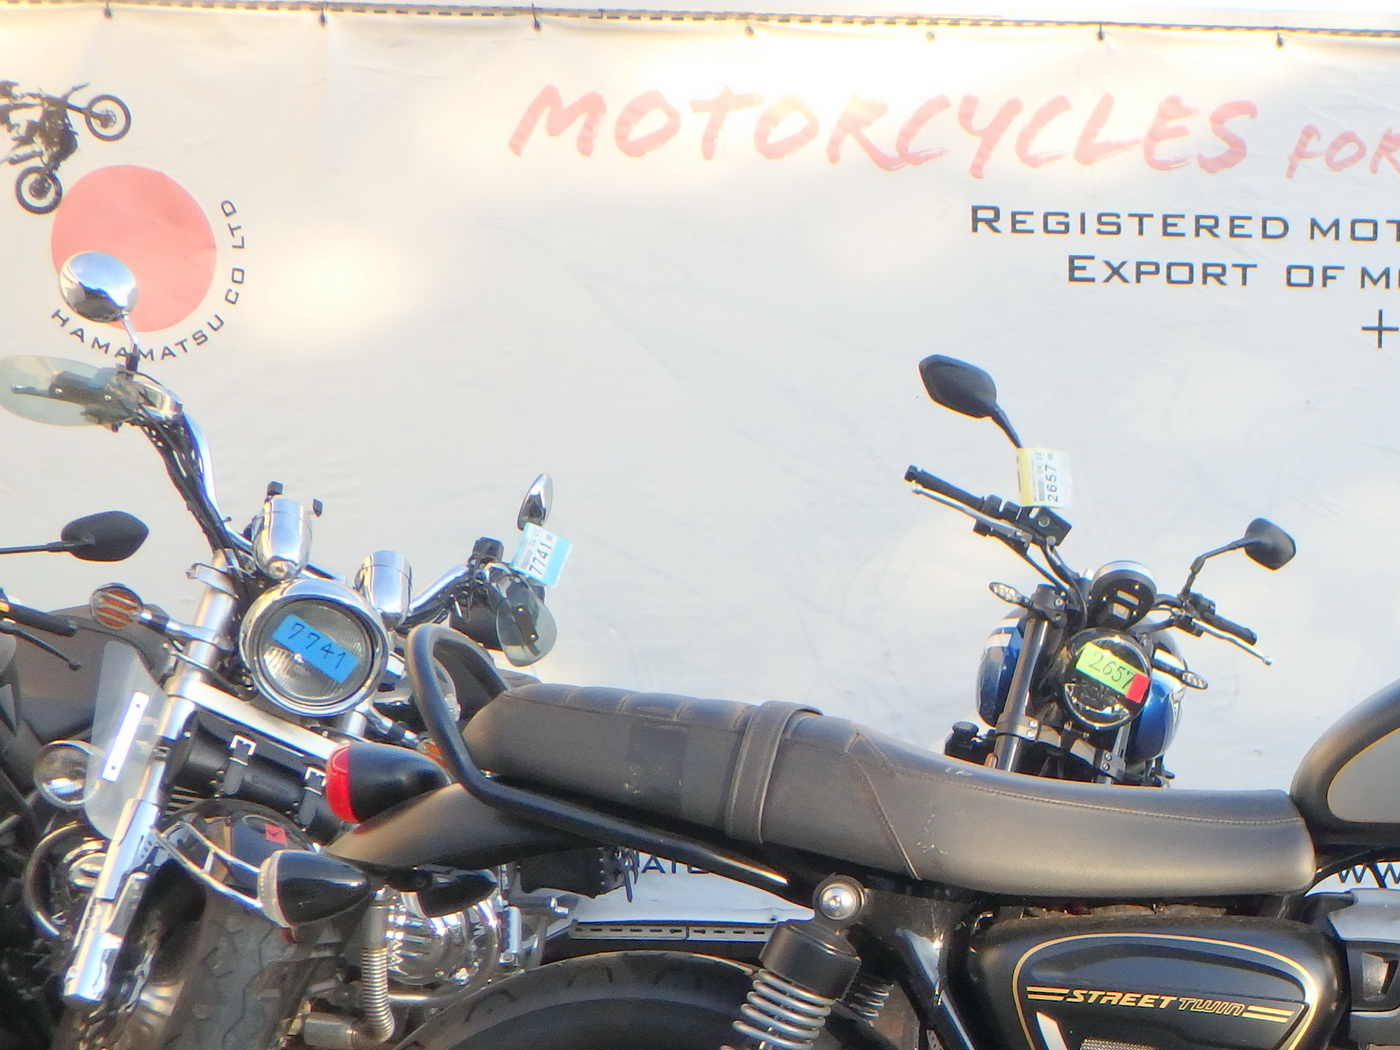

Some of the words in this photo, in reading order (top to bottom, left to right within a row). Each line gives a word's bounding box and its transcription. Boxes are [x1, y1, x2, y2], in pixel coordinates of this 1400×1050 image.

[508, 83, 1259, 179] MOTORCYCLES
[220, 200, 245, 249] LTD
[969, 205, 1290, 240] REGISTERED
[224, 267, 245, 305] CO
[1067, 255, 1258, 287] EXPORT
[1286, 264, 1345, 288] OF
[51, 308, 225, 361] HAMAMATSU
[1044, 464, 1059, 503] 2657
[529, 541, 553, 576] 7741
[287, 622, 347, 670] 7741
[1087, 650, 1135, 690] 2657
[1065, 988, 1179, 1010] STREET
[1177, 996, 1246, 1017] TWIN
